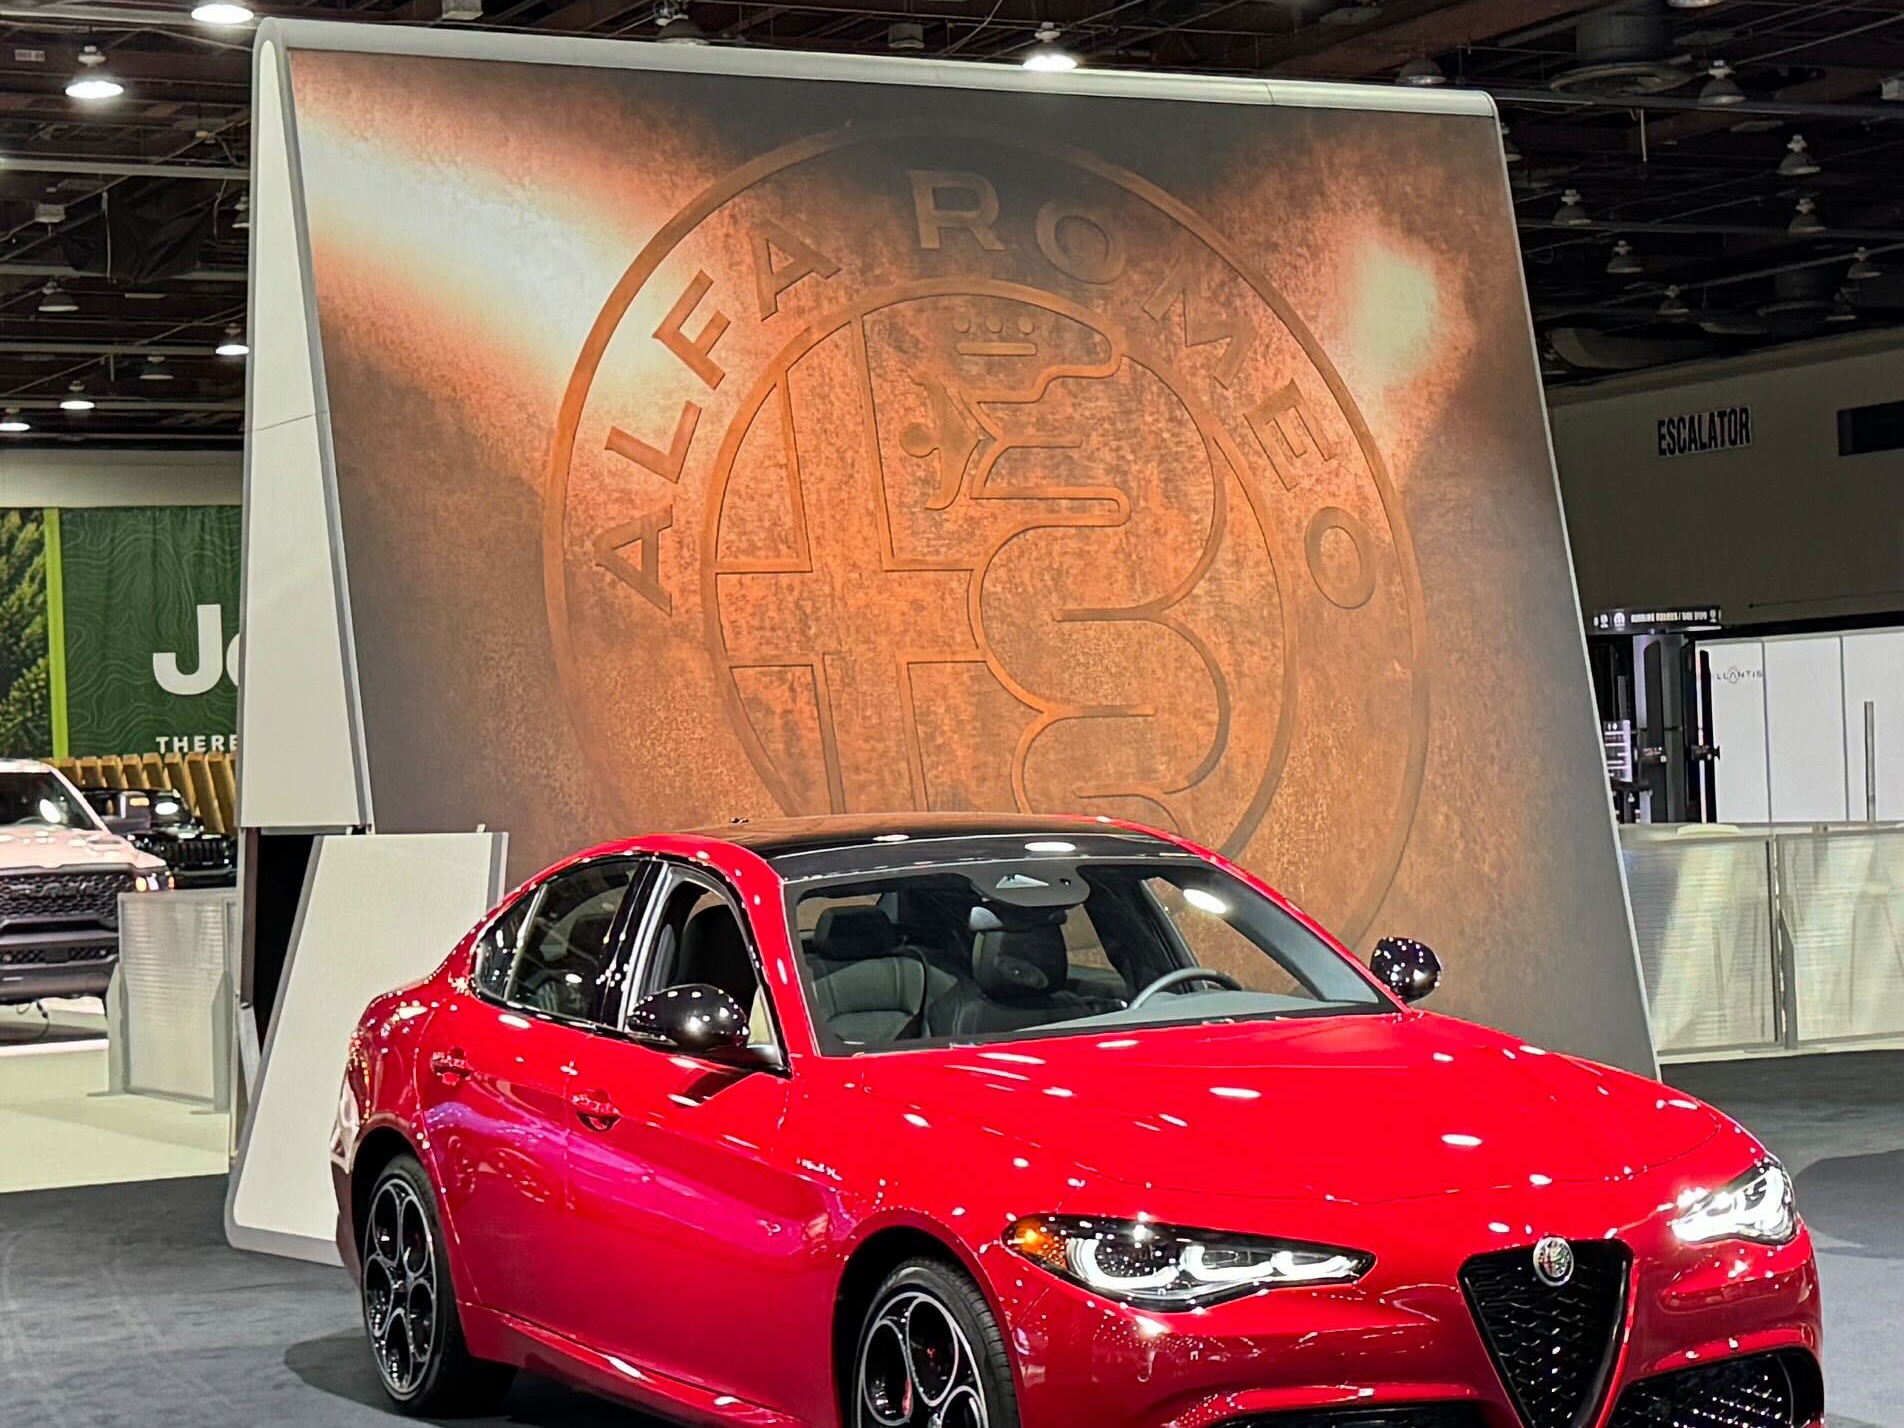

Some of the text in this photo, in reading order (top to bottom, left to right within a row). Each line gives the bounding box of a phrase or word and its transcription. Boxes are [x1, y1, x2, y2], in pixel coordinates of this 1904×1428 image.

[594, 167, 1380, 617] ALFA ROMEO
[1657, 407, 1751, 457] ESCALATOR
[155, 734, 239, 755] THERE
